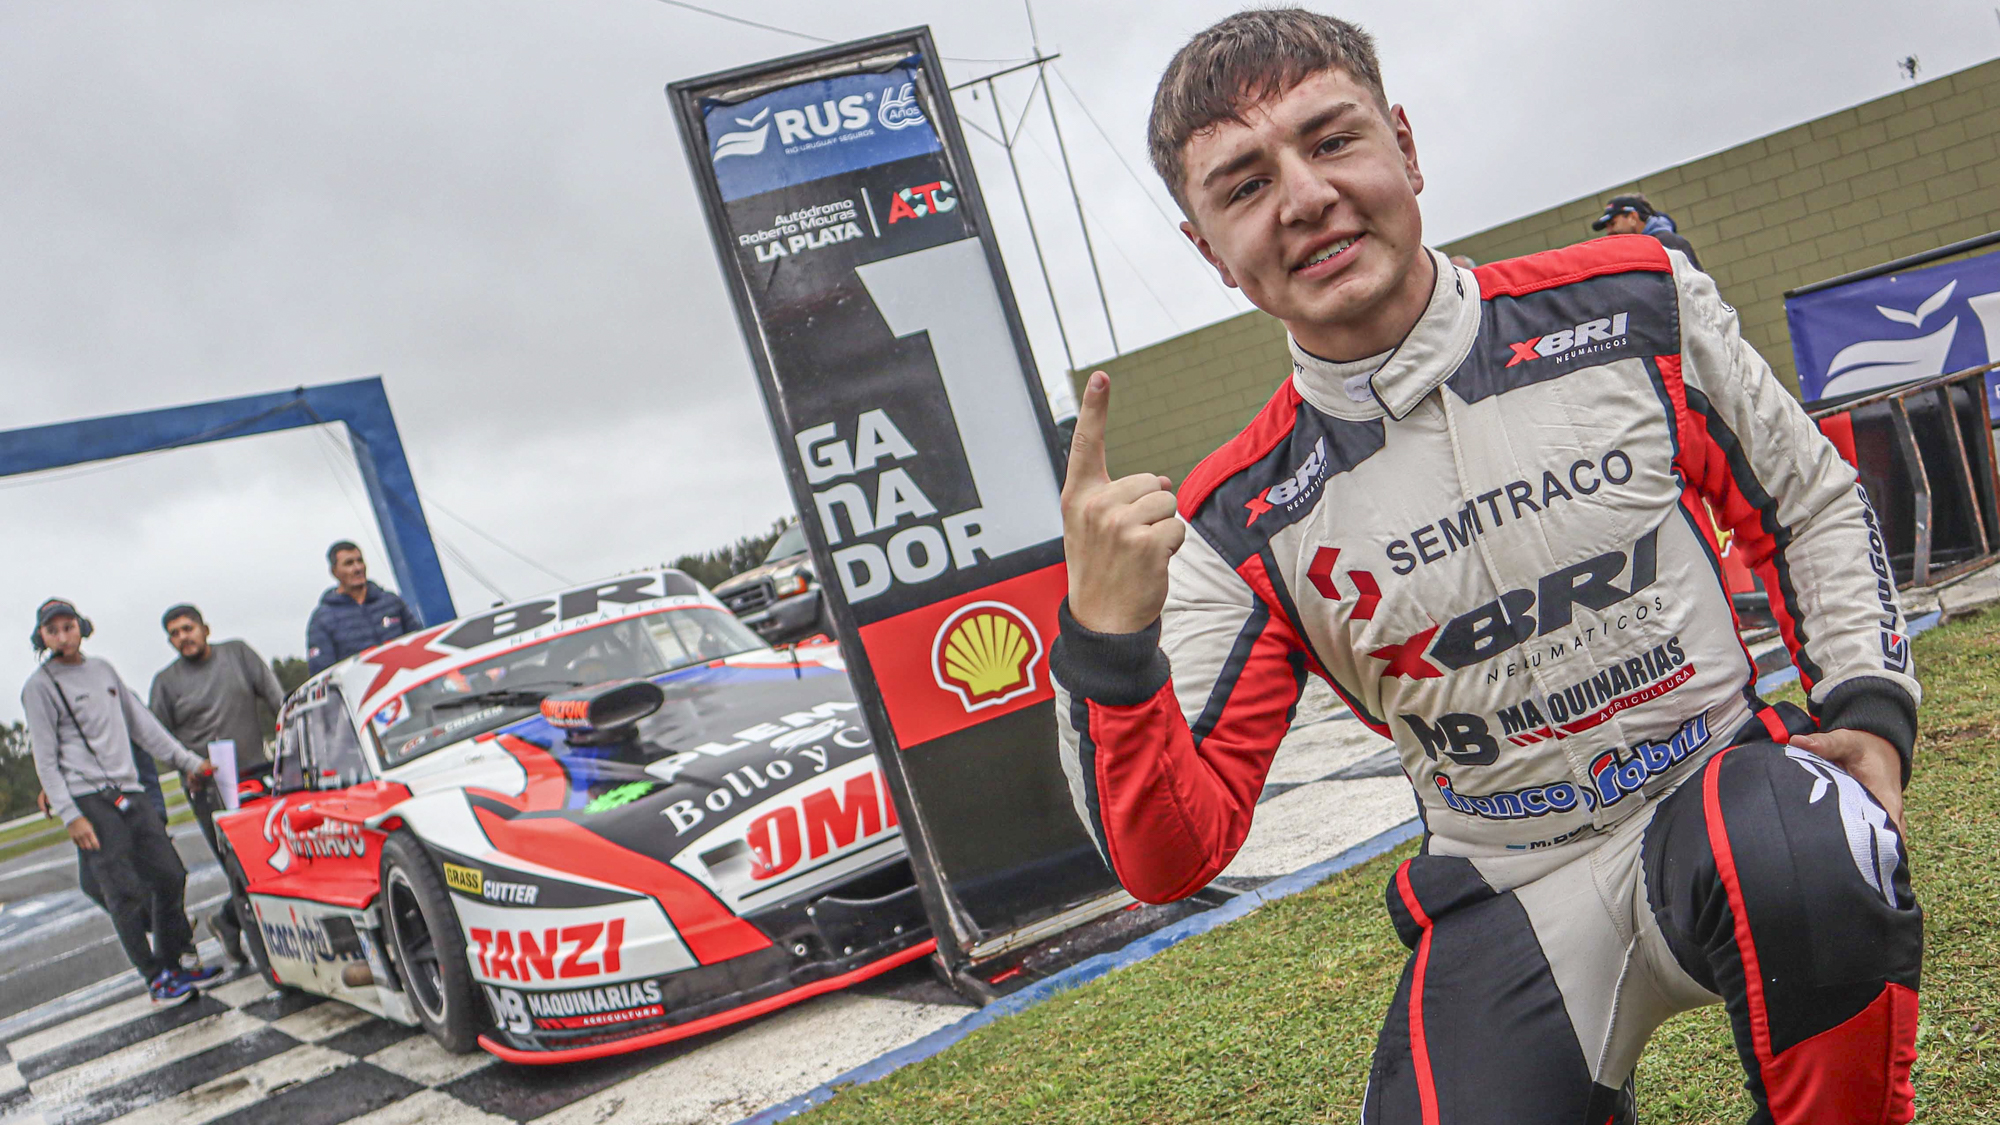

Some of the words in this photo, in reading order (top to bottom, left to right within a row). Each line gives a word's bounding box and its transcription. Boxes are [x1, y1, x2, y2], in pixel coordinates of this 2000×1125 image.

[785, 145, 799, 156] RIO
[838, 128, 875, 143] SEGUROS
[739, 223, 797, 248] Roberto
[800, 208, 857, 232] Mouras
[774, 199, 855, 227] Autódromo
[754, 242, 788, 263] LA
[789, 221, 865, 255] PLATA
[1505, 311, 1629, 368] XBRI
[1555, 336, 1628, 365] NEUMATICOS
[1244, 436, 1327, 528] XBRI
[1286, 459, 1329, 513] NEUMATICOS
[1367, 528, 1659, 680] XBRI
[358, 573, 702, 714] XBRI
[1496, 636, 1687, 736] MAQUINARIAS
[1599, 668, 1692, 722] AGRICULTURA
[660, 759, 794, 837] Bollo
[798, 745, 829, 772] y
[446, 867, 480, 890] GRASS
[483, 879, 540, 905] CUTTER
[469, 917, 626, 984] TANZI
[526, 979, 663, 1018] MAQUINARIAS
[583, 1007, 659, 1026] AGRICULTURA
